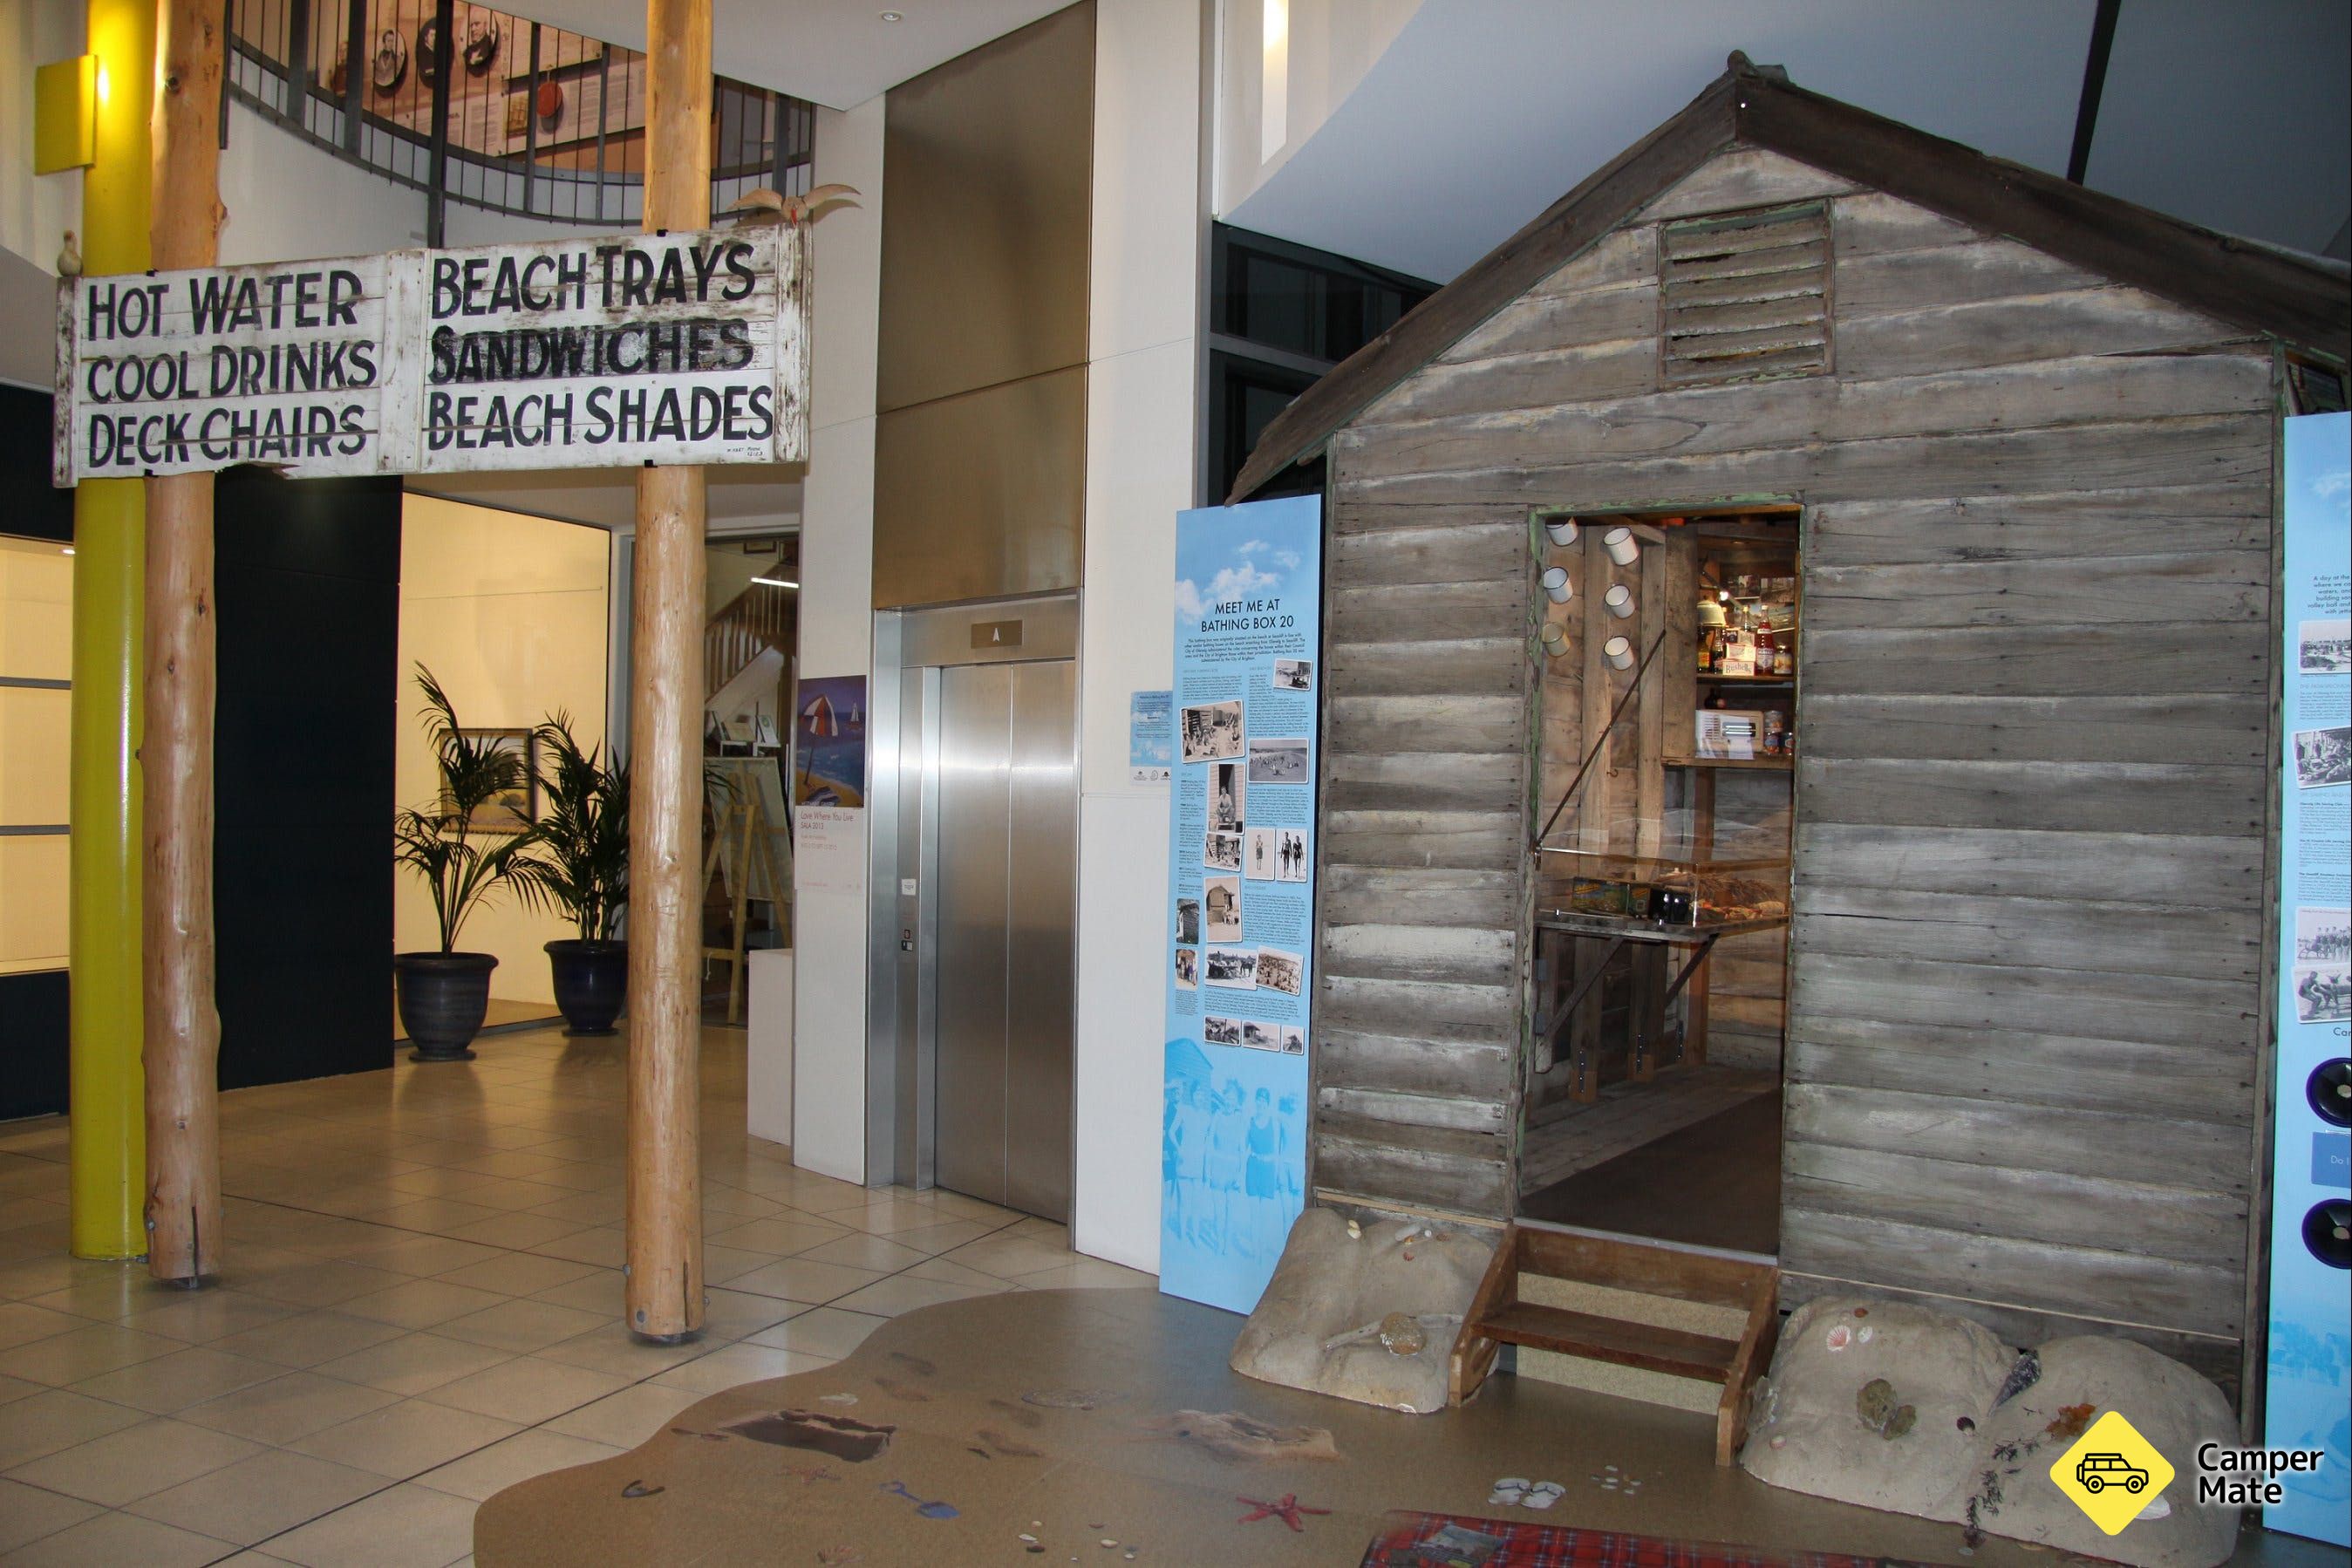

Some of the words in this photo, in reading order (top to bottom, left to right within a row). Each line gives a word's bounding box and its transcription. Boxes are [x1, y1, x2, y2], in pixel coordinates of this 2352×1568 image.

[89, 283, 169, 341] HOT
[189, 269, 363, 335] WATER
[432, 252, 587, 319] BEACH
[596, 242, 756, 308] TRAYS
[88, 351, 200, 404] COOL
[210, 339, 377, 398] DRINKS
[428, 317, 754, 385] SANDWICHES
[89, 412, 192, 468] DECK
[200, 405, 367, 461] CHAIRS
[428, 391, 573, 451] BEACH
[584, 385, 774, 444] SHADES
[1202, 618, 1250, 632] BATHING
[1254, 616, 1278, 629] BOX
[1280, 615, 1294, 627] 20
[1215, 602, 1243, 614] MEET
[1246, 600, 1263, 612] ME
[1266, 599, 1280, 610] AT
[2331, 1156, 2343, 1164] Do
